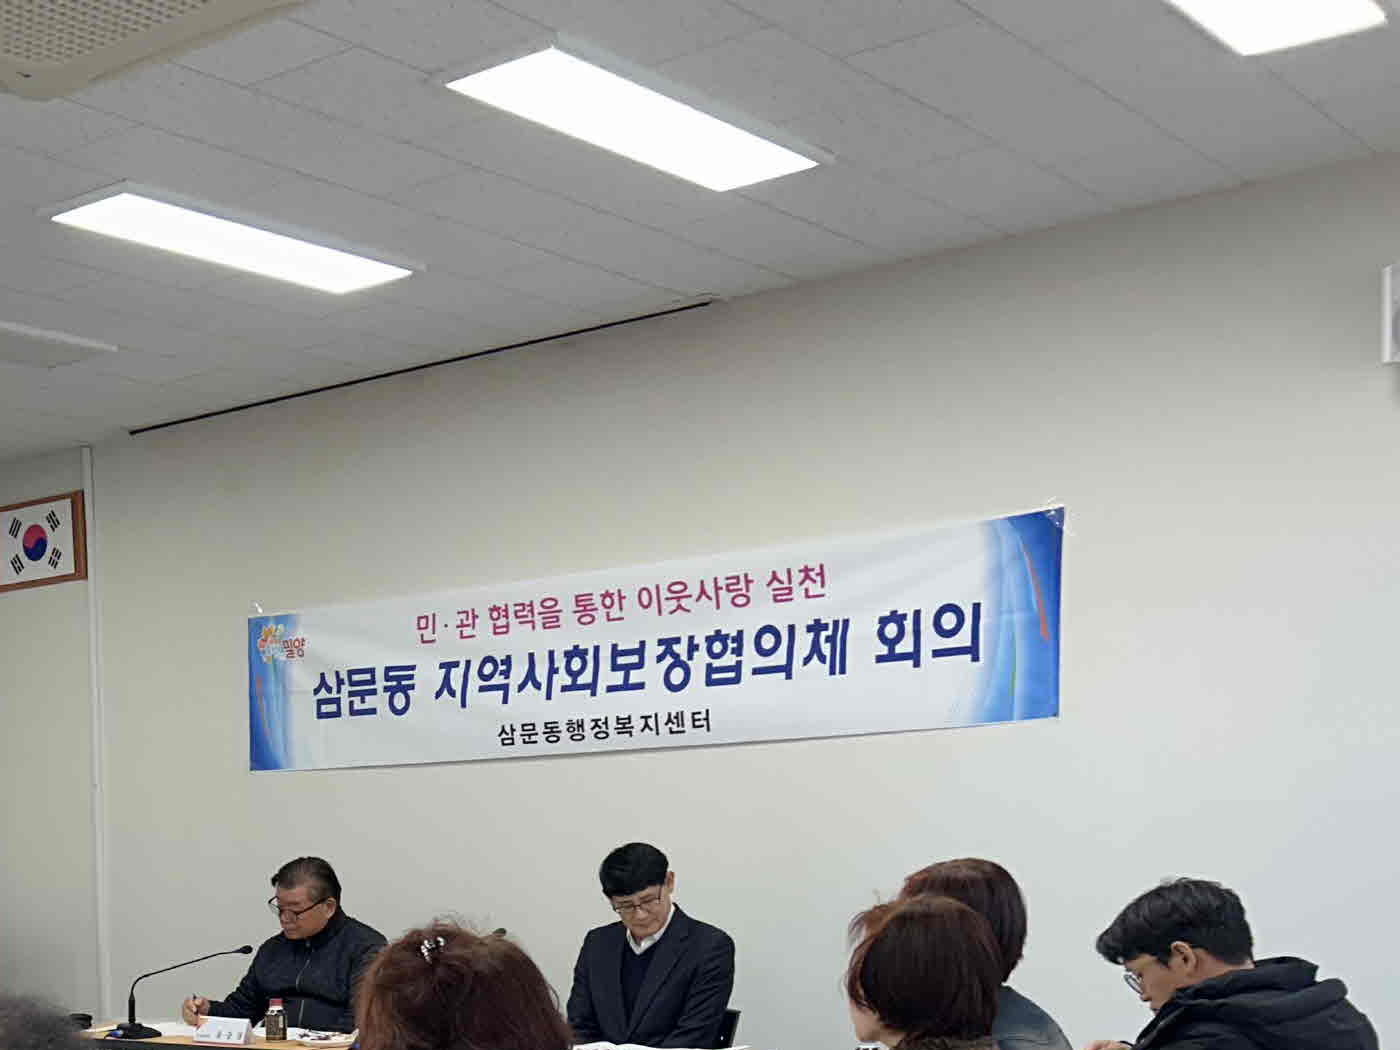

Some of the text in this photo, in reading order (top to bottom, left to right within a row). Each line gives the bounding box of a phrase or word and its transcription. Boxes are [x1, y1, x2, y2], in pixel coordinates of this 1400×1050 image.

[488, 597, 563, 636] 협력을
[572, 589, 627, 627] 통한
[637, 573, 755, 617] 이웃사랑
[766, 563, 827, 604] 실천
[313, 602, 983, 721] 삼문동 지역사회보장협의체 회의
[497, 708, 712, 747] 삼문동행정복지센터
